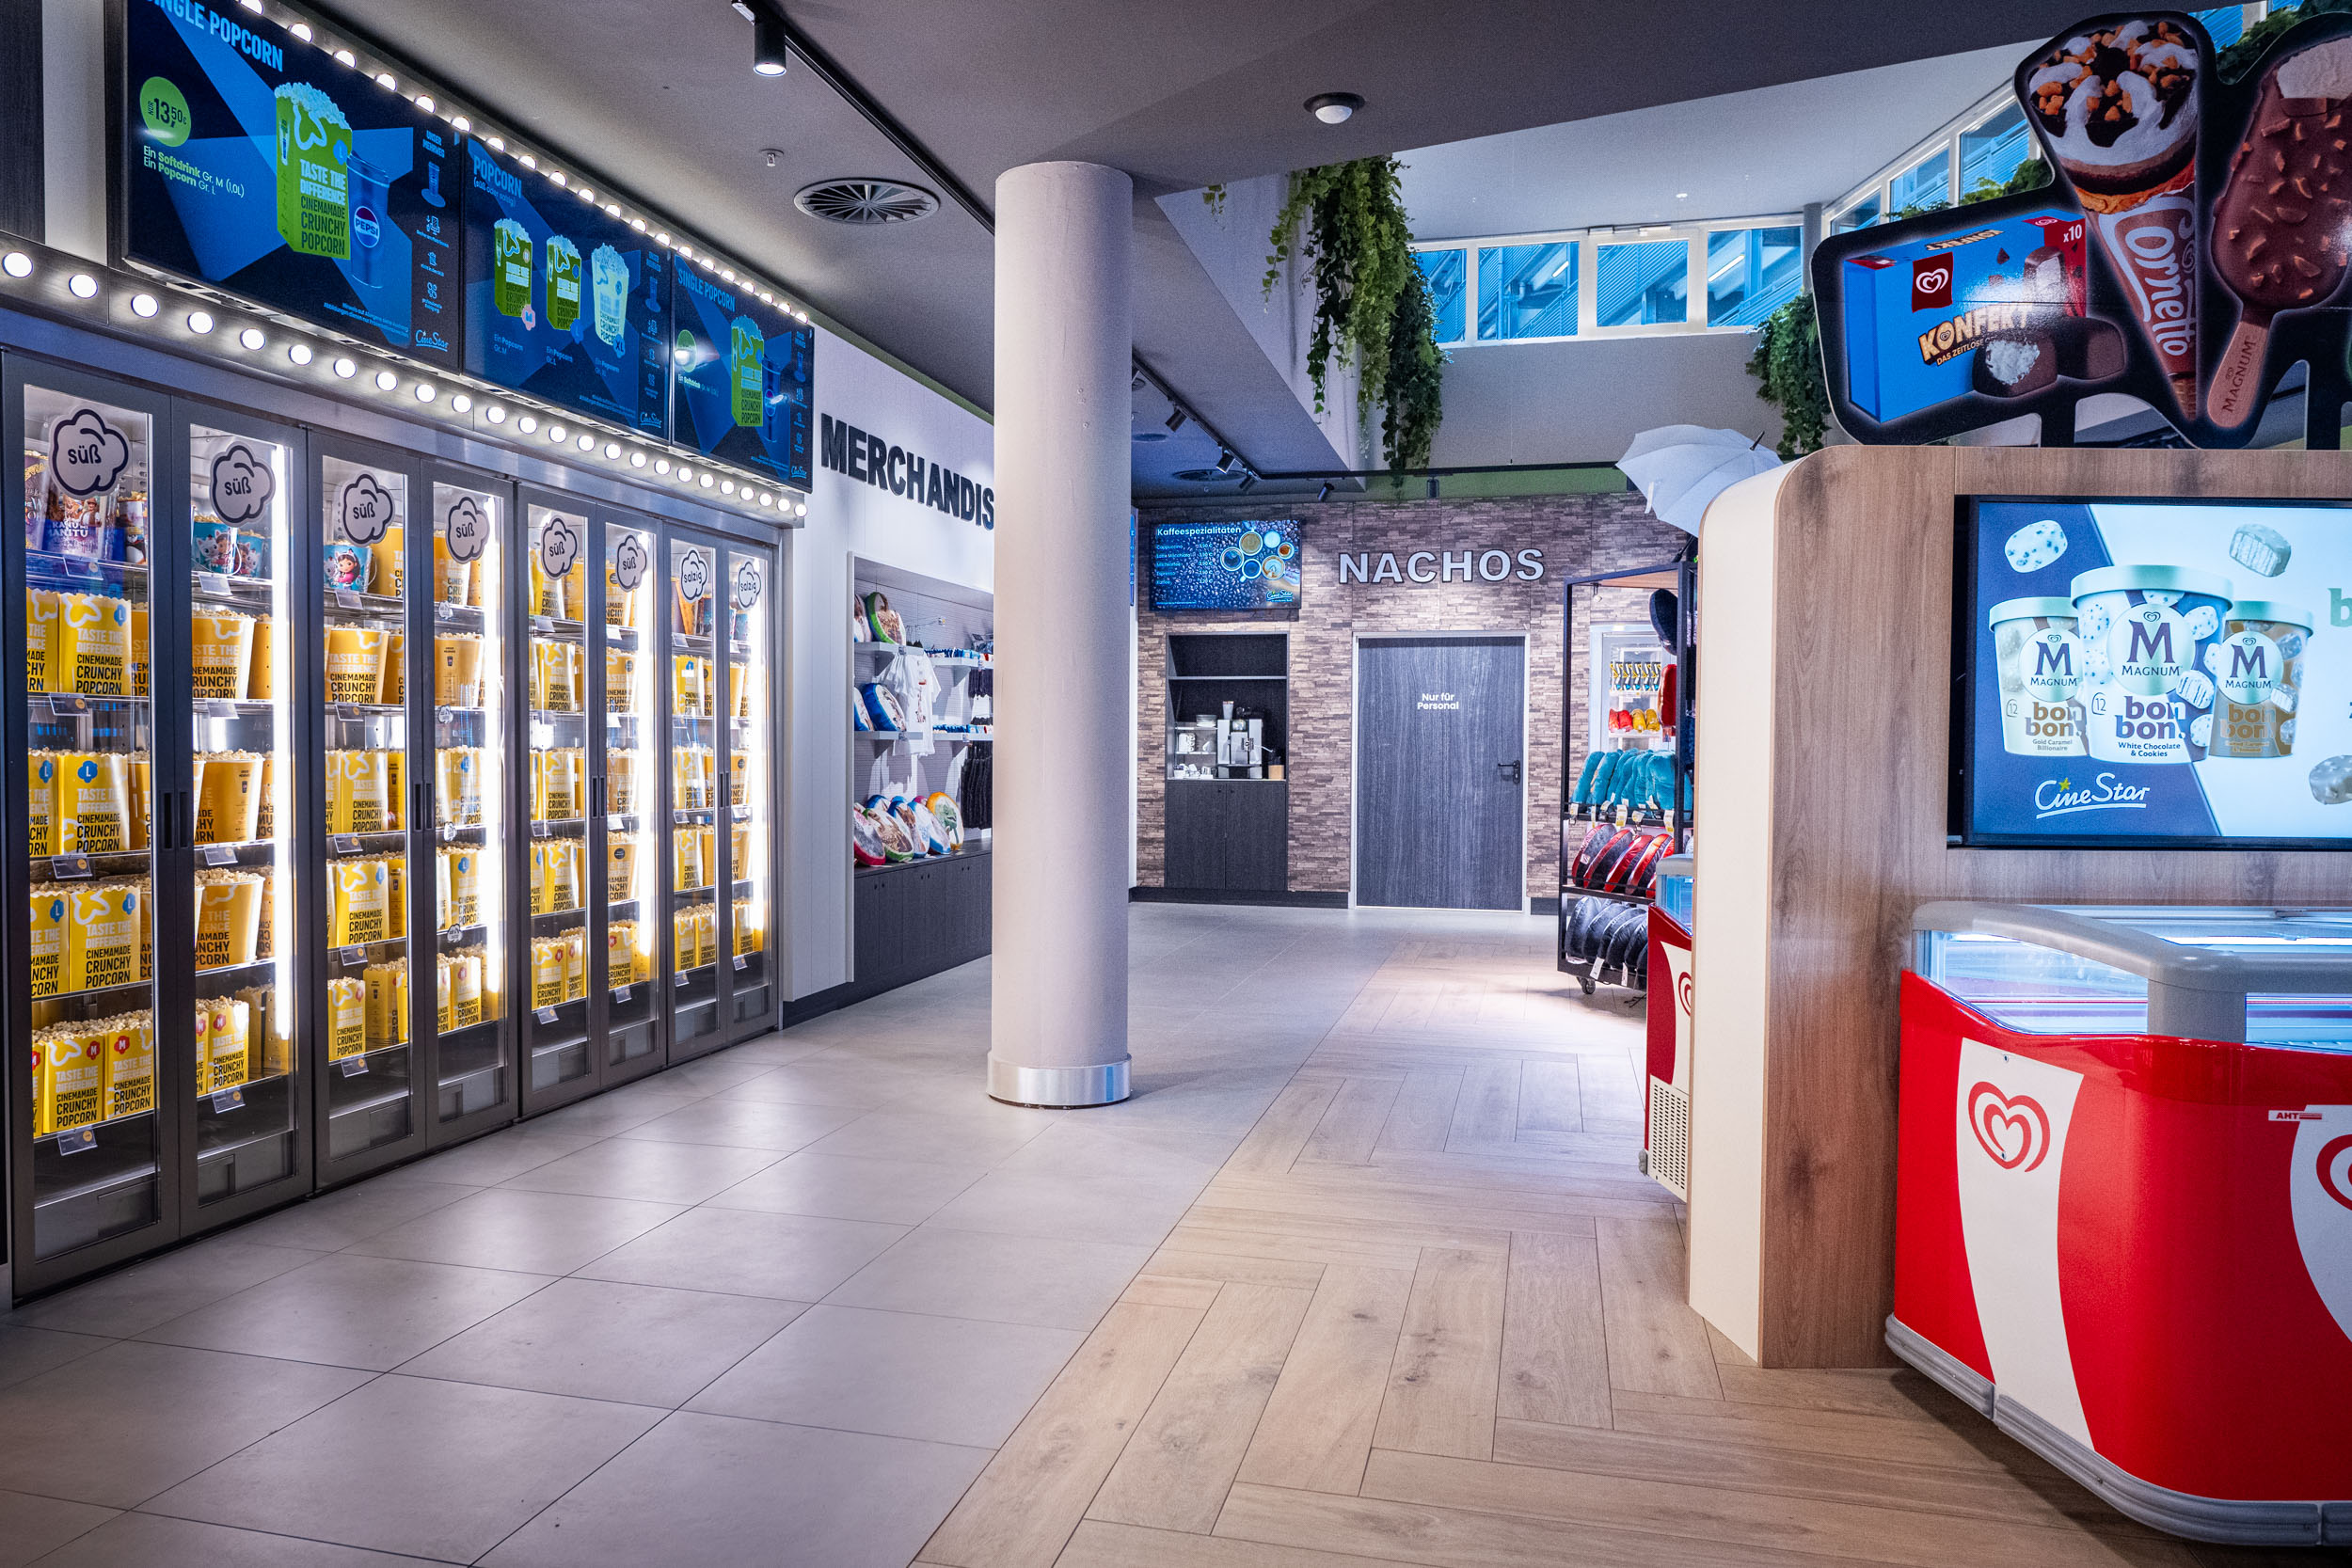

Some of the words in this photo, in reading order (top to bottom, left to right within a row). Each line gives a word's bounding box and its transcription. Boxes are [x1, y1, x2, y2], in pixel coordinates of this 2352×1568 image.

[210, 10, 282, 72] POPCORN
[144, 145, 156, 159] Ein
[158, 151, 200, 178] Softdrink
[202, 171, 215, 183] Gr.
[215, 177, 224, 187] M
[144, 156, 156, 170] Ein
[159, 162, 197, 186] Popcorn
[199, 181, 210, 192] Gr.
[212, 184, 216, 195] L
[299, 159, 328, 183] TASTE
[330, 169, 346, 191] THE
[474, 155, 522, 198] POPCORN
[300, 178, 346, 206] DIFFERENCE
[301, 196, 345, 219] CINEMAMADE
[301, 212, 345, 236] CRUNCHY
[2063, 224, 2083, 245] x10
[301, 231, 345, 256] POPCORN
[677, 268, 704, 295] SINGLE
[706, 280, 736, 312] POPCORN
[1918, 302, 2033, 362] KONFEKT
[415, 329, 449, 351] CineStar
[502, 336, 523, 353] Popcorn
[615, 340, 625, 353] XL
[1936, 353, 1952, 366] DAS
[1952, 339, 1984, 357] ZEITLOSE
[2222, 338, 2256, 414] MAGNUM
[741, 411, 761, 424] POPCORN
[68, 444, 102, 465] süß
[224, 476, 251, 496] süß
[353, 503, 375, 520] süß
[455, 522, 475, 538] süß
[1156, 527, 1242, 537] Kaffeespezialitäten
[548, 541, 565, 557] süß
[622, 555, 637, 570] süß
[1338, 548, 1546, 584] NACHOS
[683, 563, 703, 584] salzig
[739, 576, 756, 594] salzig
[119, 610, 123, 621] L
[28, 623, 45, 637] THE
[77, 627, 106, 642] TASTE
[108, 630, 123, 643] THE
[76, 641, 123, 656] DIFFERENCE
[2127, 619, 2176, 663] M
[218, 644, 239, 656] THE
[77, 654, 123, 667] CINEMAMADE
[329, 653, 361, 663] TASTE
[362, 654, 378, 664] THE
[2035, 641, 2074, 675] M
[2230, 643, 2268, 678] M
[76, 665, 123, 681] CRUNCHY
[330, 673, 376, 682] CINEMAMADE
[2122, 665, 2180, 676] MAGNUM
[75, 680, 122, 695] POPCORN
[330, 682, 376, 693] CRUNCHY
[2030, 677, 2077, 687] MAGNUM
[2225, 680, 2272, 689] MAGNUM
[332, 693, 374, 704] POPCORN
[1422, 693, 1438, 702] Nur
[1440, 692, 1454, 702] für
[2095, 698, 2106, 711] 12
[1417, 701, 1459, 710] Personal
[2009, 703, 2018, 714] 12
[2032, 702, 2082, 721] bon
[2123, 696, 2186, 720] bon
[2228, 704, 2277, 722] bon
[2115, 715, 2186, 739] bon.
[2118, 741, 2141, 750] White
[86, 766, 91, 777] L
[34, 789, 48, 801] THE
[77, 788, 106, 800] TASTE
[2035, 772, 2150, 816] CineStar
[548, 800, 571, 809] CRUNCHY
[77, 813, 120, 824] CINEMAMADE
[353, 809, 383, 821] CRUNCHY
[548, 810, 570, 819] POPCORN
[76, 824, 120, 838] CRUNCHY
[352, 820, 382, 832] POPCORN
[76, 838, 119, 853] POPCORN
[56, 905, 60, 916] L
[208, 911, 230, 922] THE
[349, 910, 382, 920] CINEMAMADE
[86, 922, 115, 937] TASTE
[118, 920, 132, 933] THE
[349, 918, 383, 932] CRUNCHY
[45, 927, 60, 941] THE
[348, 929, 382, 944] POPCORN
[86, 945, 131, 959] CINEMAMADE
[86, 956, 131, 974] CRUNCHY
[86, 970, 131, 989] POPCORN
[537, 988, 561, 998] CRUNCHY
[537, 996, 561, 1007] POPCORN
[119, 1039, 126, 1050] M
[337, 1032, 363, 1047] CRUNCHY
[91, 1045, 97, 1055] M
[337, 1042, 363, 1056] POPCORN
[113, 1058, 137, 1071] TASTE
[139, 1054, 151, 1067] THE
[214, 1051, 244, 1065] CINEMAMADE
[56, 1068, 83, 1083] TASTE
[84, 1066, 98, 1079] THE
[214, 1059, 244, 1076] CRUNCHY
[114, 1075, 151, 1091] CINEMAMADE
[214, 1069, 244, 1087] POPCORN
[56, 1087, 98, 1102] CINEMAMADE
[114, 1084, 151, 1102] CRUNCHY
[56, 1097, 98, 1116] CRUNCHY
[114, 1096, 151, 1116] POPCORN
[56, 1110, 97, 1128] POPCORN
